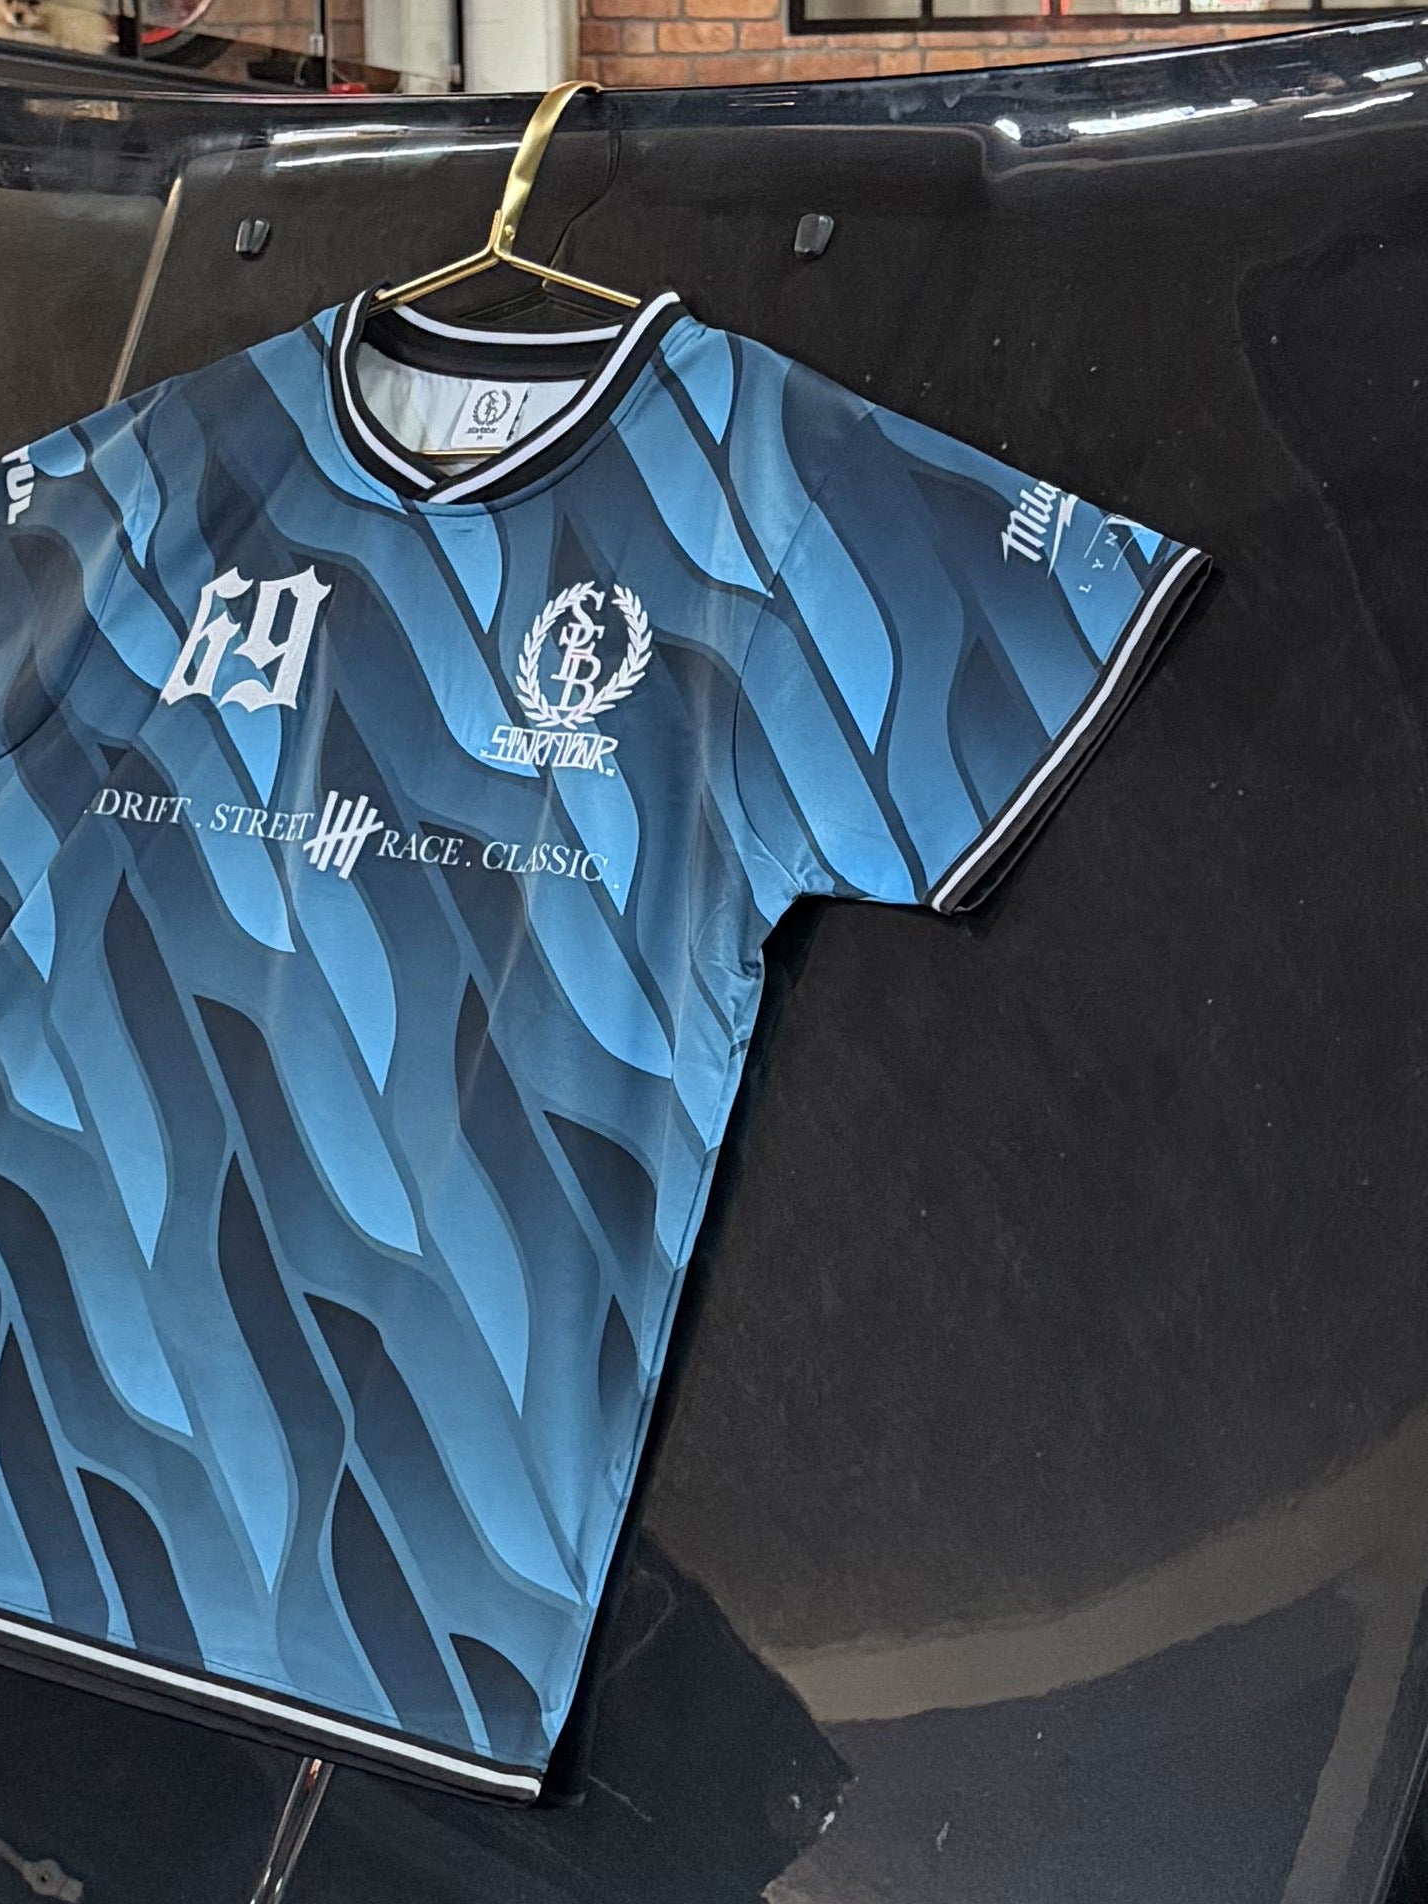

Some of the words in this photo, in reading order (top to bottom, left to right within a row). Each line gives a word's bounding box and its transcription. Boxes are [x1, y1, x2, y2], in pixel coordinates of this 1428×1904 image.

[160, 565, 332, 713] 69
[210, 803, 316, 844] STREET
[376, 829, 463, 867] RACE
[482, 840, 609, 883] CLASSIC
